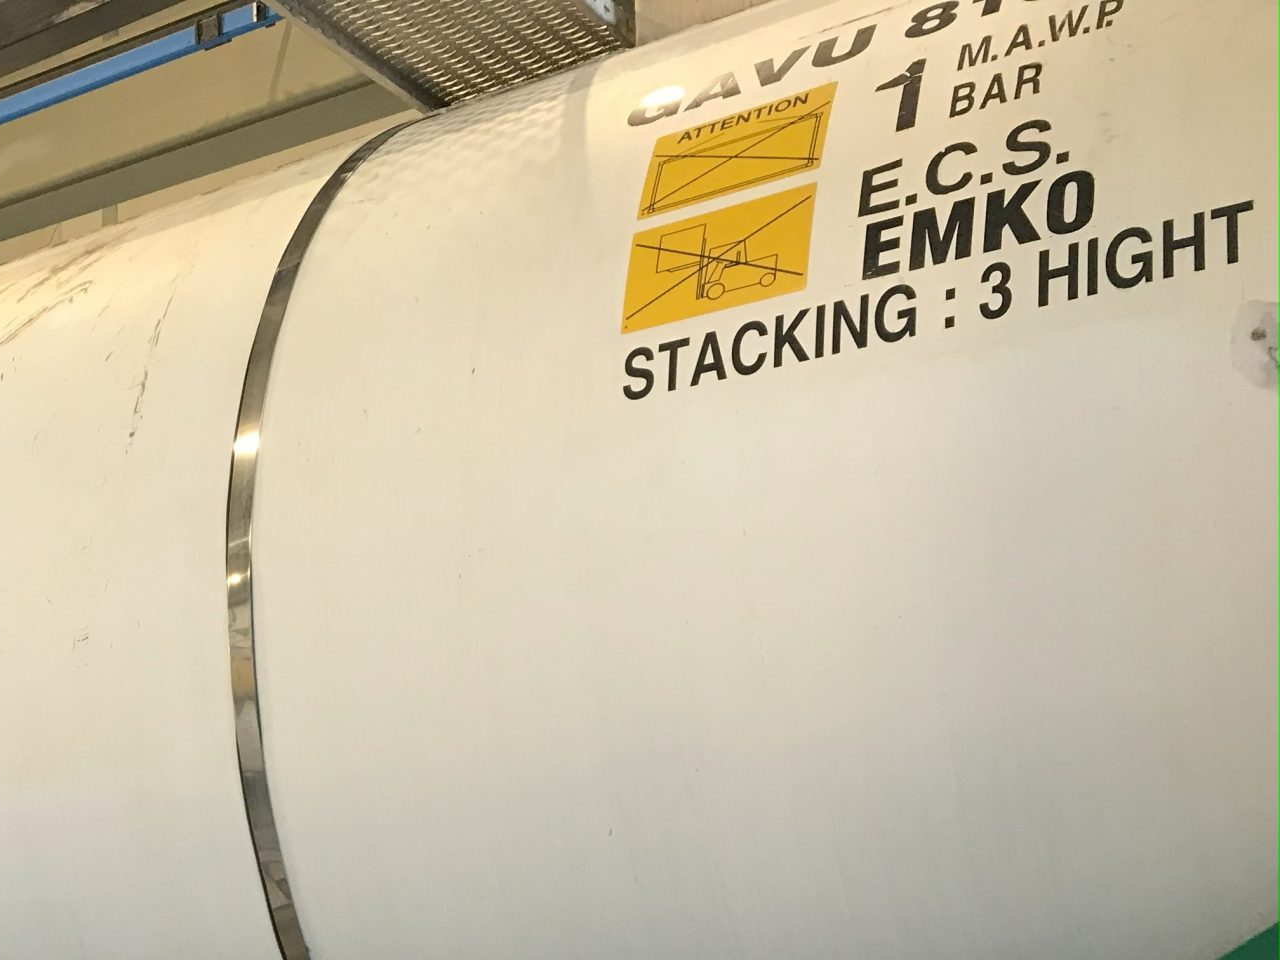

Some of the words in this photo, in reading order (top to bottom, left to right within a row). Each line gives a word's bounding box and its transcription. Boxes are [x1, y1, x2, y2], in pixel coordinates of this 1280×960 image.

[677, 93, 810, 145] ATTENTION
[875, 58, 927, 133] 1
[948, 62, 1044, 119] BAR
[858, 119, 1069, 218] E.C.S.
[622, 283, 917, 401] STACKING
[979, 261, 1013, 320] 3
[1038, 200, 1254, 308] HIGHT
